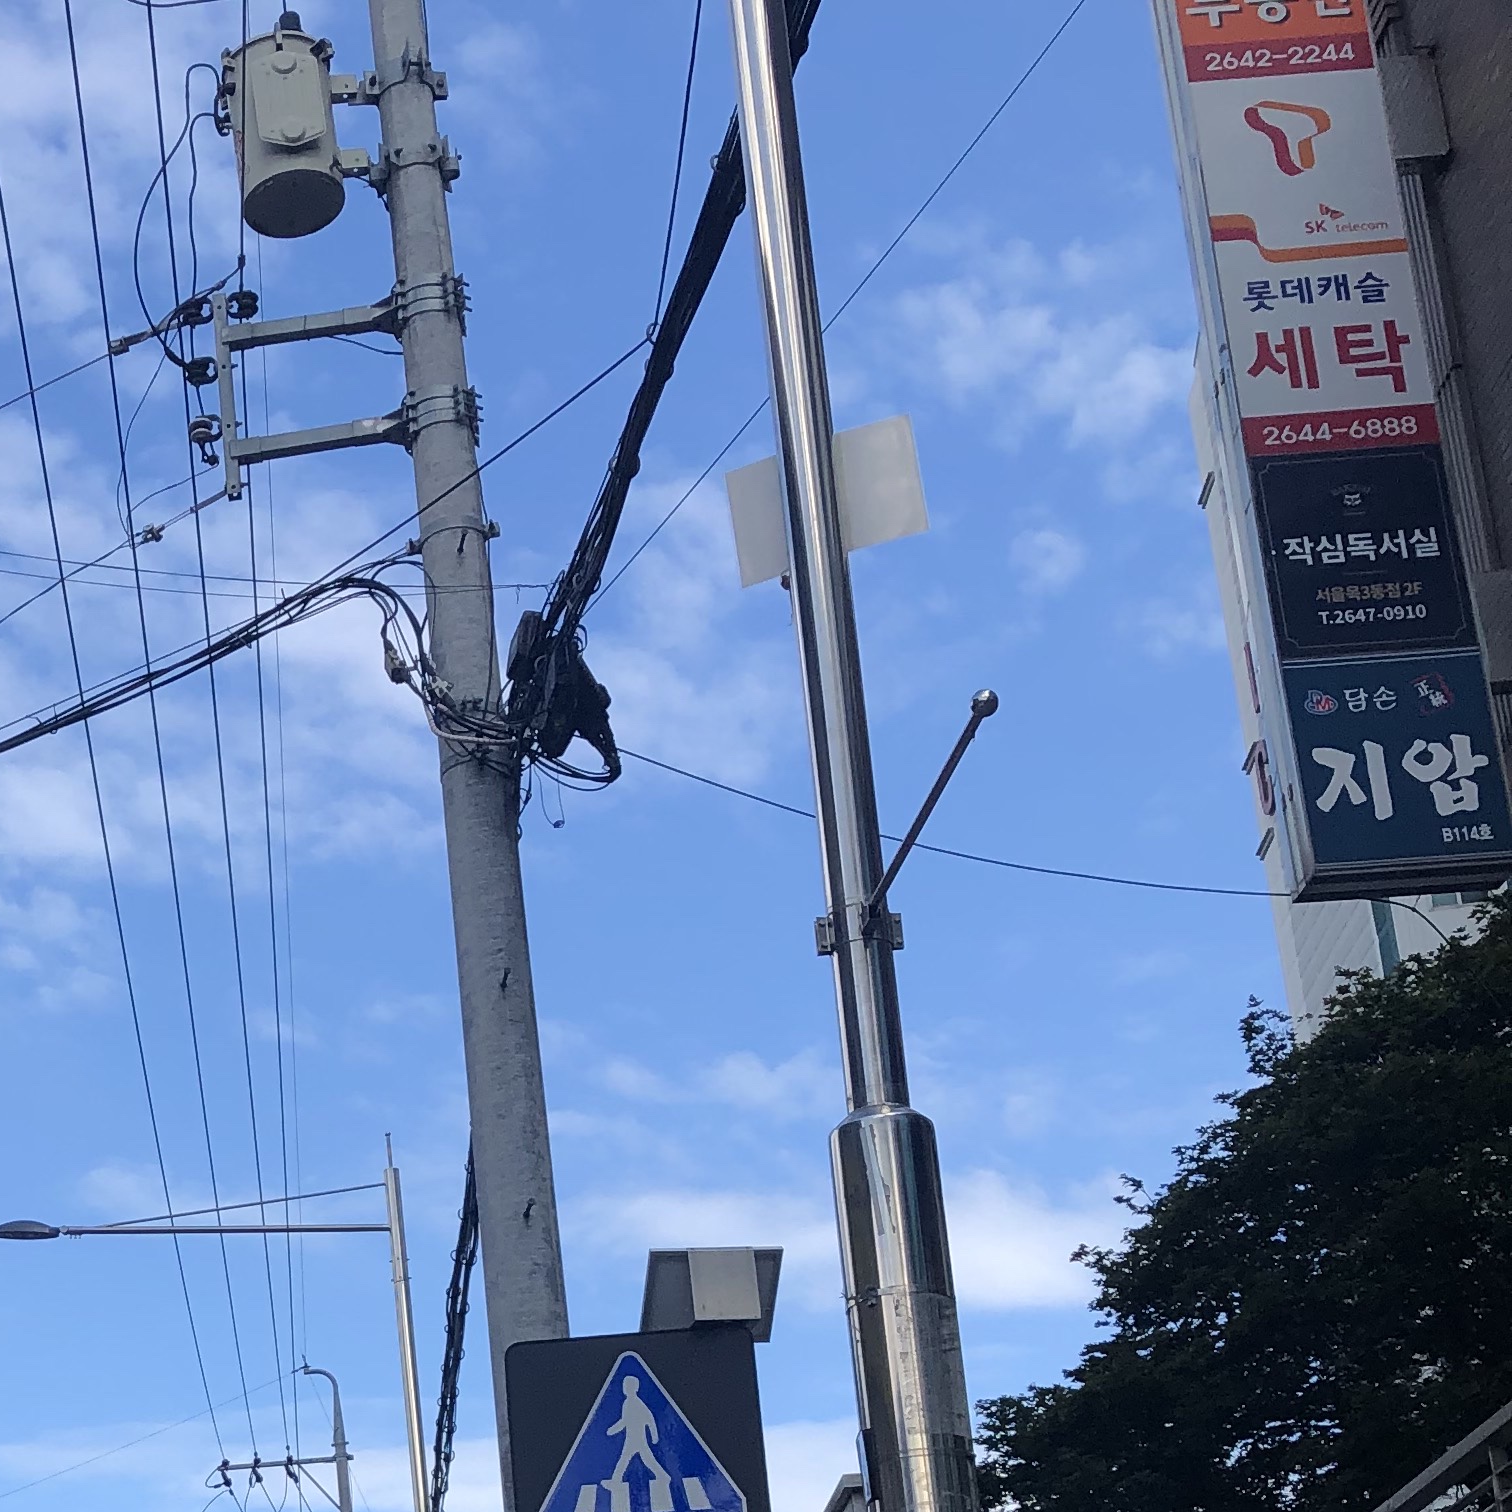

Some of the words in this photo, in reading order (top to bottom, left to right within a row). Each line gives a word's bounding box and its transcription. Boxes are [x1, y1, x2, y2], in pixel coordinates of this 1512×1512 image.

[1204, 43, 1355, 72] 2642-2244
[1304, 220, 1327, 234] SK
[1335, 219, 1388, 233] telecom
[1242, 272, 1390, 312] 롯데캐슬
[1247, 320, 1410, 393] 세탁
[1263, 416, 1417, 446] 2644-6888
[1284, 527, 1441, 566] 작심독서실
[1318, 604, 1427, 626] T.2647-0910
[1343, 686, 1397, 712] 담손
[1311, 734, 1488, 819] 지압
[1442, 822, 1494, 843] B114호
